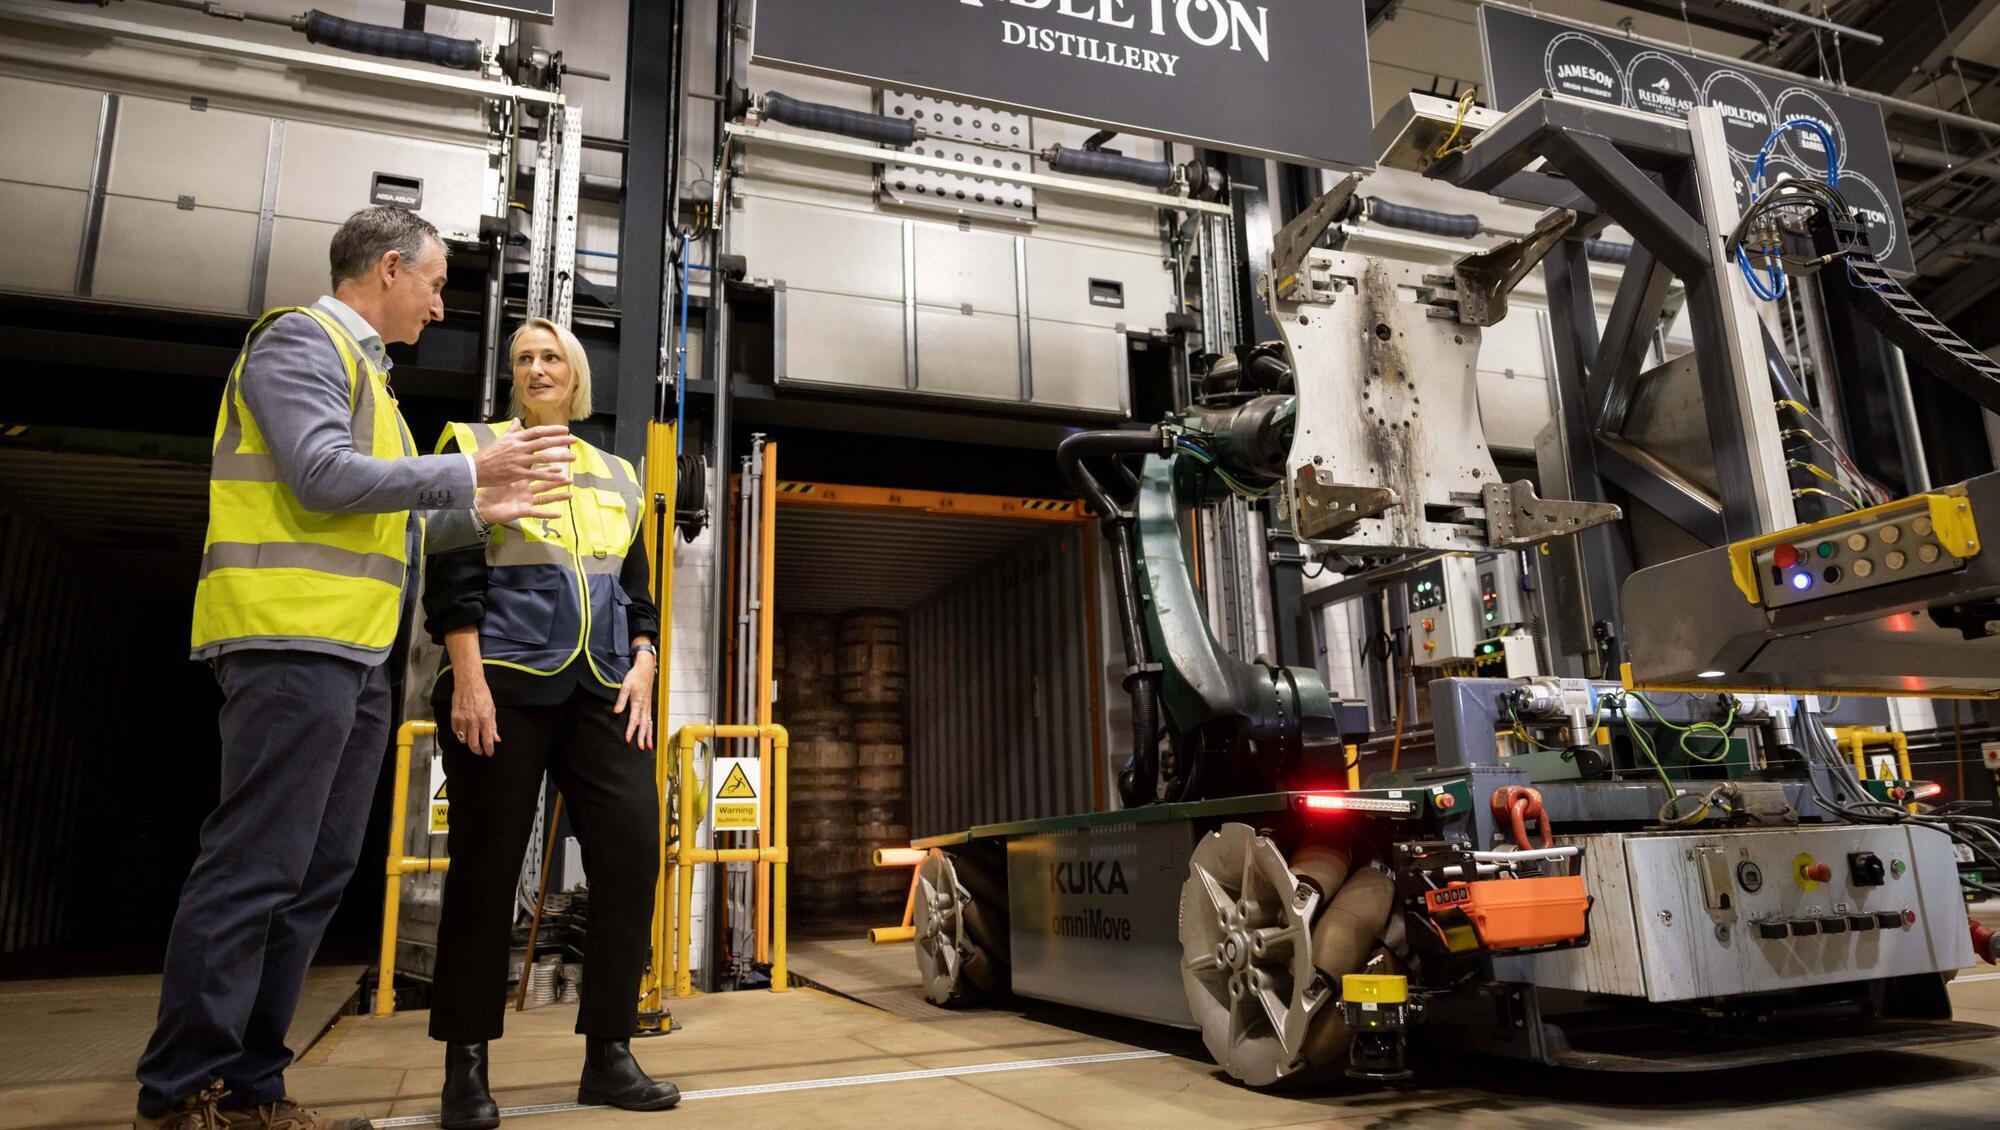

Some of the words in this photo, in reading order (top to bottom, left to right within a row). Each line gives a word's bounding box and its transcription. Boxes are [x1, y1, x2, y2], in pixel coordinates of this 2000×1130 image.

[1001, 20, 1180, 76] DISTILLERY
[1558, 64, 1613, 88] JAMESON
[1638, 88, 1694, 110] REDBREAST
[719, 806, 754, 815] Warning
[1051, 861, 1129, 895] KUKA
[1053, 909, 1131, 941] omniMove
